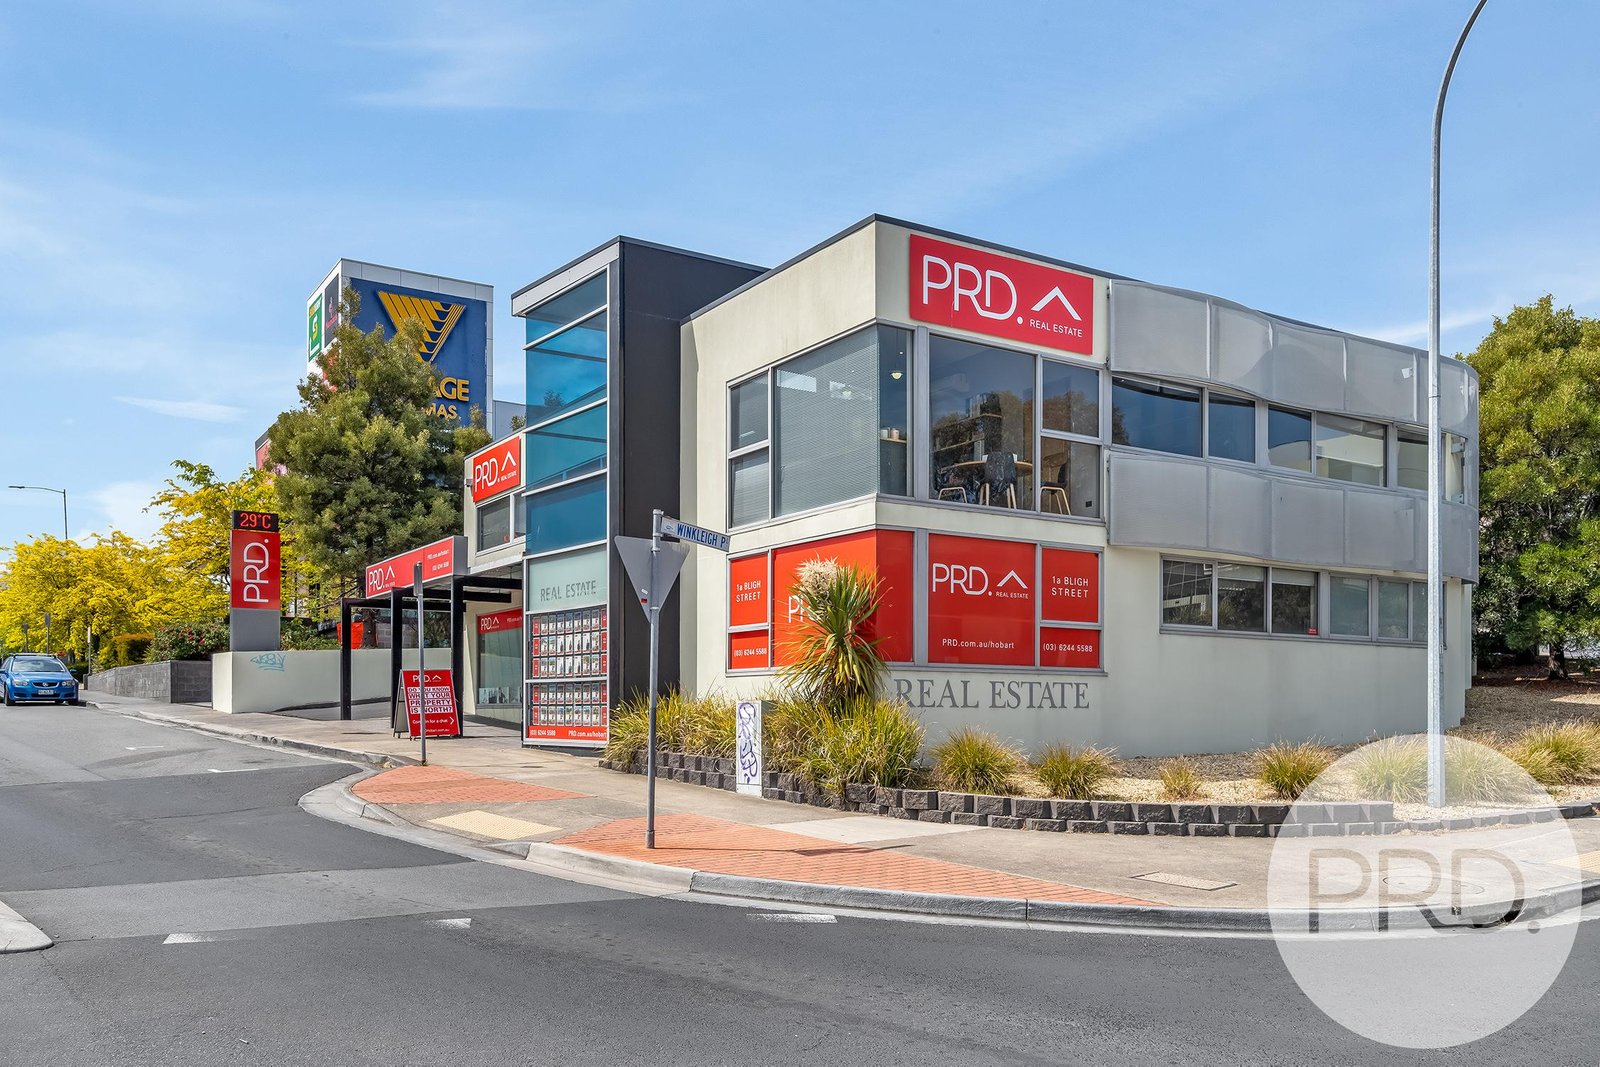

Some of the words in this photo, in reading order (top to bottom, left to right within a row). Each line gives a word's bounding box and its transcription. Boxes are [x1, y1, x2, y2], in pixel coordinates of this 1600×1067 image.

[1029, 319, 1051, 331] REAL
[1053, 323, 1083, 338] ESTATE
[240, 512, 272, 529] 29°C
[677, 523, 718, 547] WINKLEIGH
[744, 580, 761, 590] BLIGH
[1052, 575, 1061, 584] 1a
[1064, 576, 1089, 586] BLIGH
[540, 585, 562, 602] REAL
[565, 580, 596, 598] ESTATE
[736, 591, 761, 602] STREET
[1051, 587, 1089, 598] STREET
[942, 638, 1015, 649] PRD.com.au/hobart
[1043, 643, 1056, 652] (03)
[1077, 644, 1093, 653] 5588
[743, 648, 755, 656] 6244
[756, 647, 767, 655] 5588
[893, 678, 980, 709] REAL
[988, 680, 1090, 709] ESTATE
